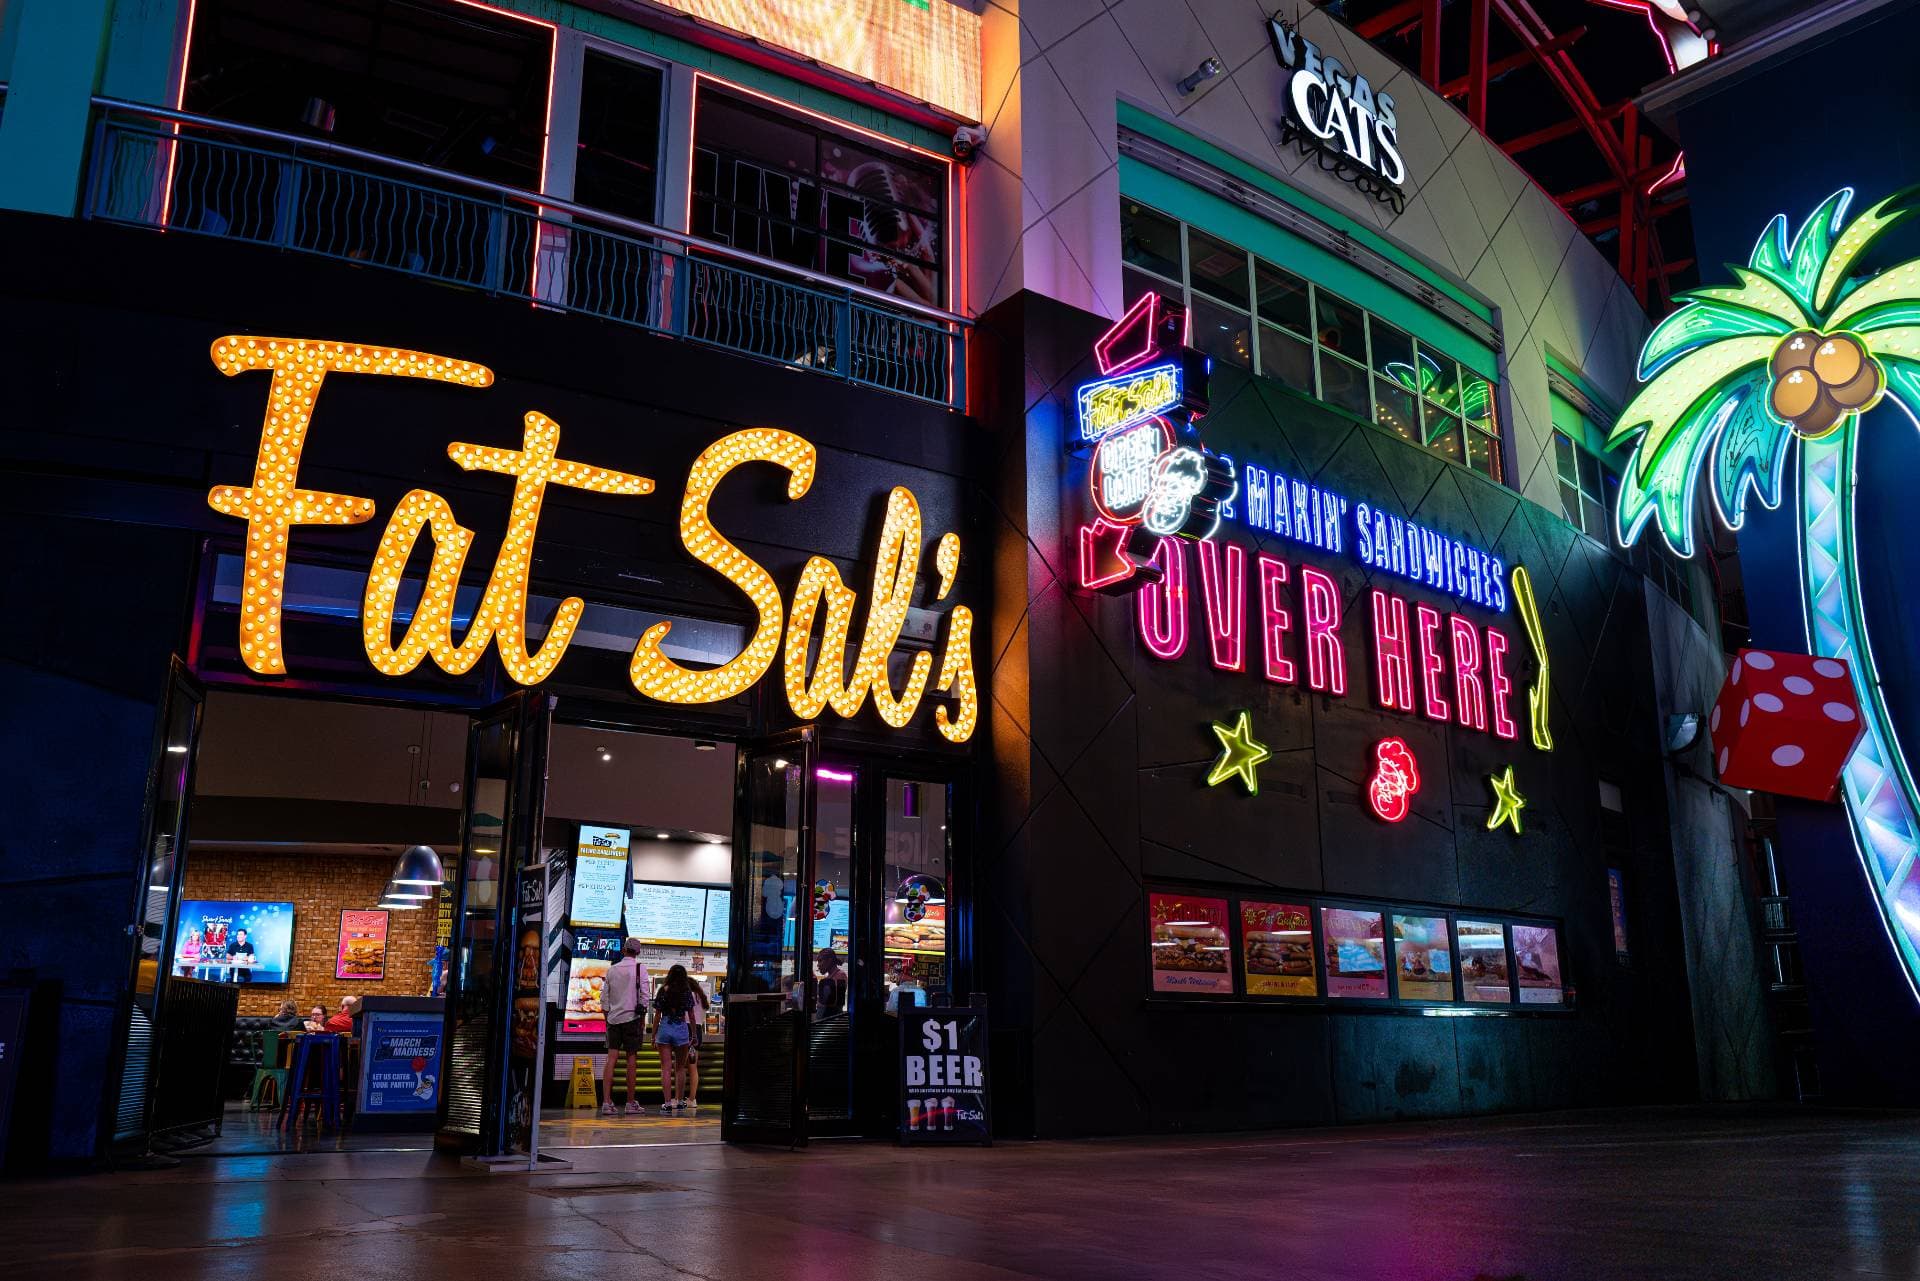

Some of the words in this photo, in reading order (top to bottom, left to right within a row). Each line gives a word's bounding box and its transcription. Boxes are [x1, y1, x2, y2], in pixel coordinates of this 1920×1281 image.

[1267, 18, 1397, 129] VEGAS
[1291, 69, 1405, 185] CATS
[690, 146, 870, 288] LIVE
[207, 335, 656, 686] Fat
[629, 427, 978, 743] Sal's
[1246, 462, 1348, 553] MAKIN'
[1356, 501, 1506, 613] SANDWICHES
[1138, 533, 1348, 698] OVER
[1370, 584, 1519, 742] HERE
[577, 936, 593, 951] Fat
[390, 1038, 422, 1048] MARCH
[393, 1047, 436, 1057] MADNESS
[906, 1055, 983, 1087] BEER
[922, 1018, 958, 1053] $1
[372, 1073, 383, 1081] LET
